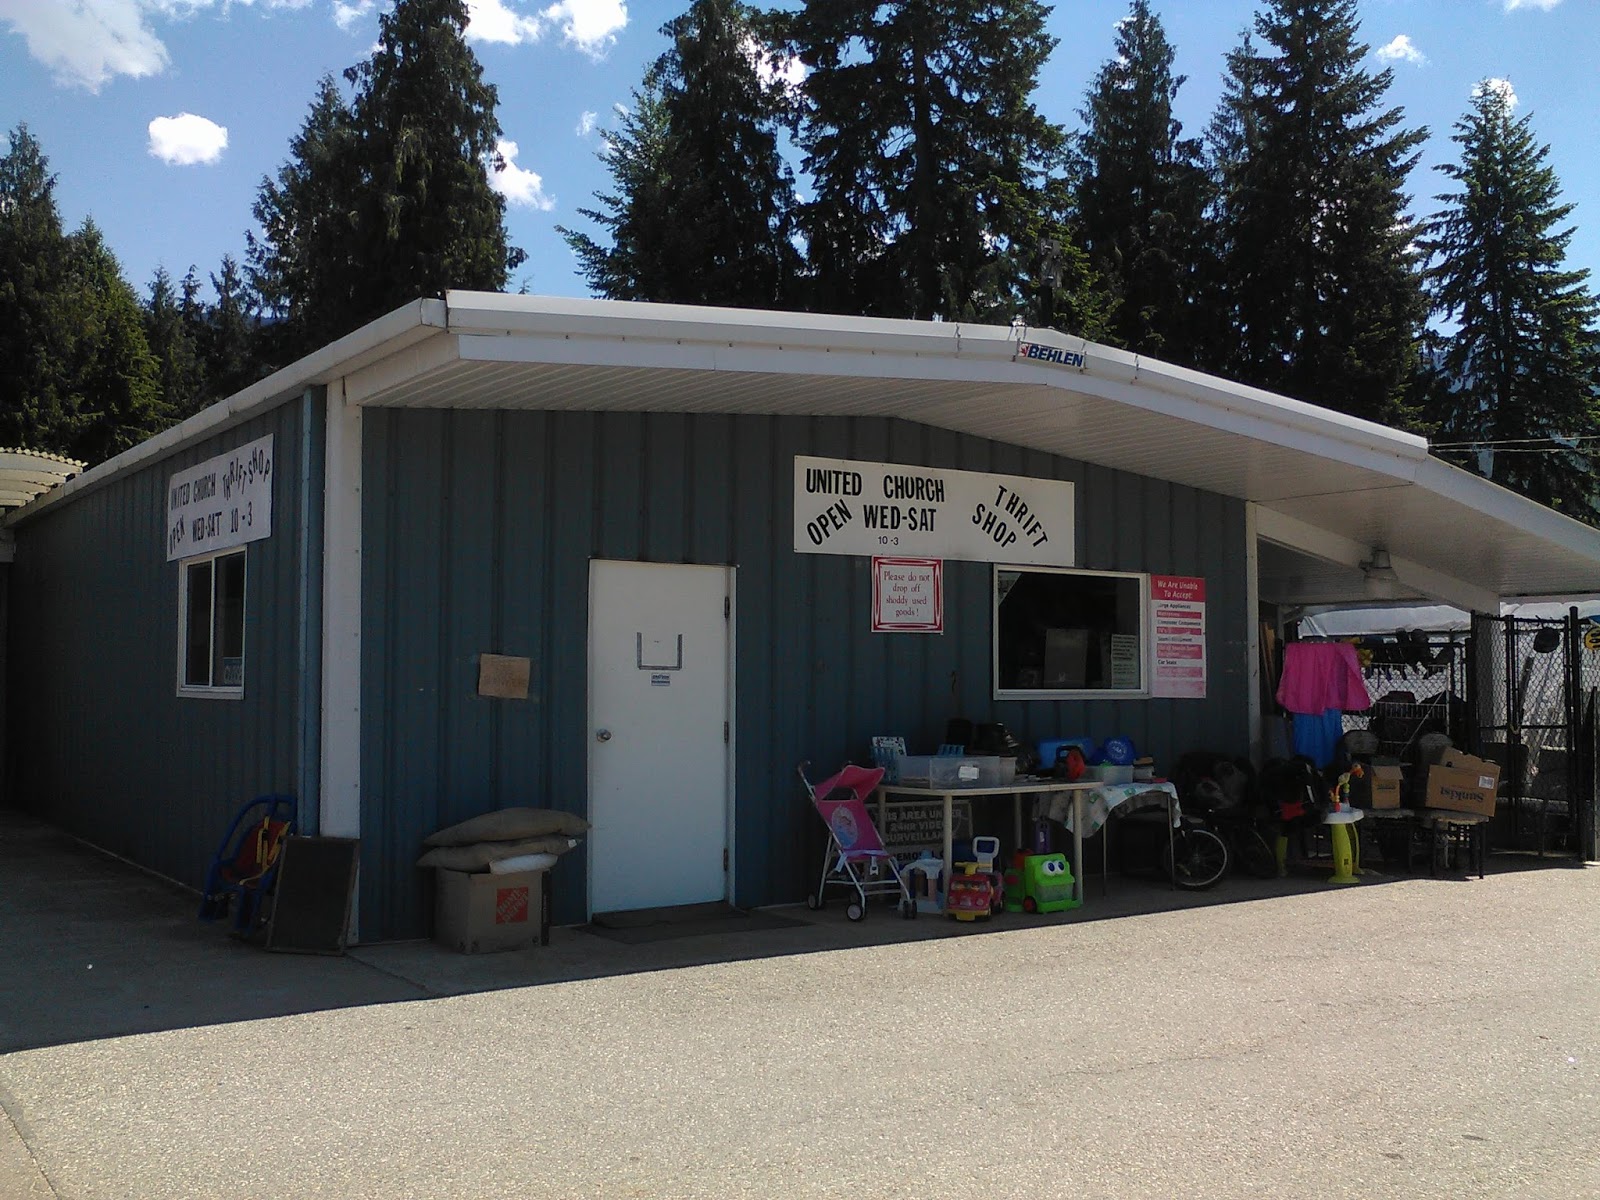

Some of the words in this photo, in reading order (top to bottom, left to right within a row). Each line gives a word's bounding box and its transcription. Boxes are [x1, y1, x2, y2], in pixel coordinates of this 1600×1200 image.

[1027, 344, 1084, 368] BEHLEN
[171, 483, 190, 511] UNITED
[193, 473, 216, 503] CHURCH
[222, 457, 247, 501] THRIFT
[248, 447, 271, 485] SHOP
[806, 468, 862, 496] UNITED
[883, 474, 945, 503] CHURCH
[806, 499, 853, 546] OPEN
[863, 504, 937, 532] WED-SAT
[995, 485, 1049, 548] THRIFT
[972, 503, 1017, 548] SHOP
[884, 570, 905, 581] Please
[908, 571, 917, 582] do
[919, 574, 930, 582] not
[892, 583, 908, 594] drop
[911, 583, 921, 593] off
[1157, 580, 1167, 588] We
[1167, 581, 1178, 589] Are
[1179, 581, 1198, 590] Unable
[886, 595, 908, 606] shoddy
[911, 595, 927, 605] used
[1164, 590, 1172, 598] To
[1440, 786, 1485, 803] Sunkist
[900, 810, 926, 820] AREA
[918, 820, 944, 830] VIDE
